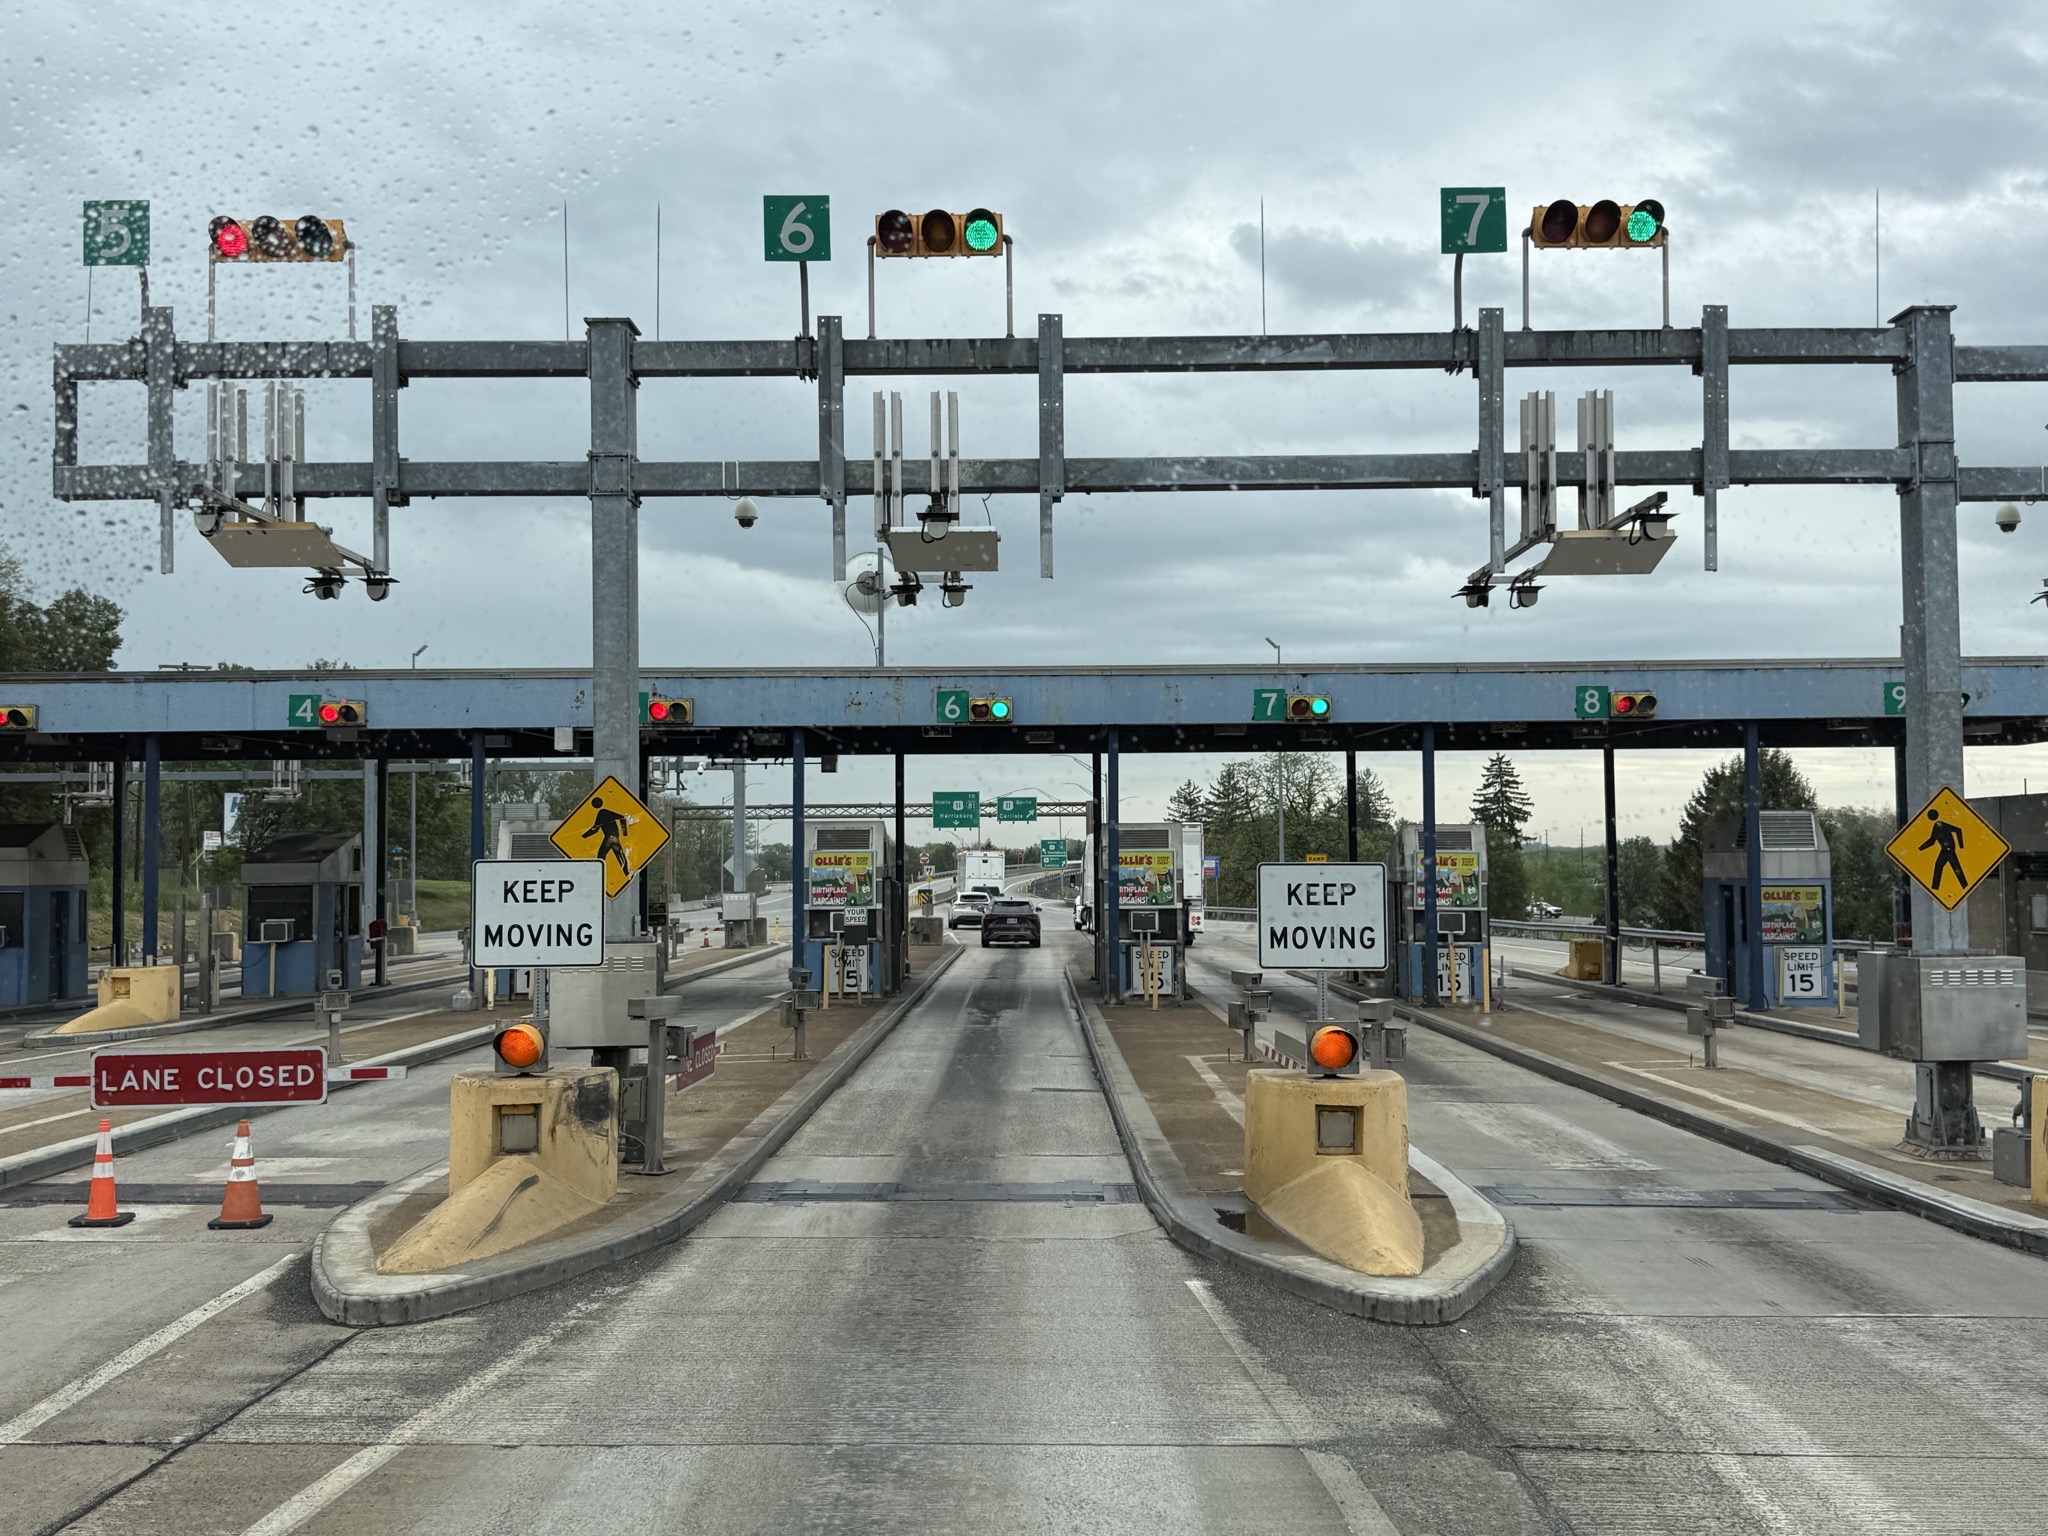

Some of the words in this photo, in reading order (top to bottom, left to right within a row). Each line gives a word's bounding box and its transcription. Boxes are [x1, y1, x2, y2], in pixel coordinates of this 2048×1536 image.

[780, 201, 815, 254] 6
[1456, 194, 1490, 246] 7
[100, 209, 132, 258] 5
[944, 695, 960, 719] 6
[1261, 693, 1277, 716] 7
[1584, 689, 1600, 714] 8
[1892, 686, 1906, 709] 9
[295, 698, 313, 723] 4
[503, 880, 575, 904] KEEP
[812, 886, 847, 894] BIRTHPLACE
[1119, 896, 1148, 905] ARGAINS!
[1287, 883, 1356, 906] KEEP
[846, 908, 865, 916] YOUR
[484, 923, 593, 948] MOVING
[1269, 926, 1376, 949] MOVING
[831, 949, 865, 957] SEED
[1438, 952, 1466, 961] PEED
[1783, 952, 1819, 961] SPEED
[1787, 963, 1816, 972] LIMIT
[1789, 974, 1814, 992] 15
[101, 1068, 180, 1092] LANE
[197, 1065, 315, 1092] CLOSED
